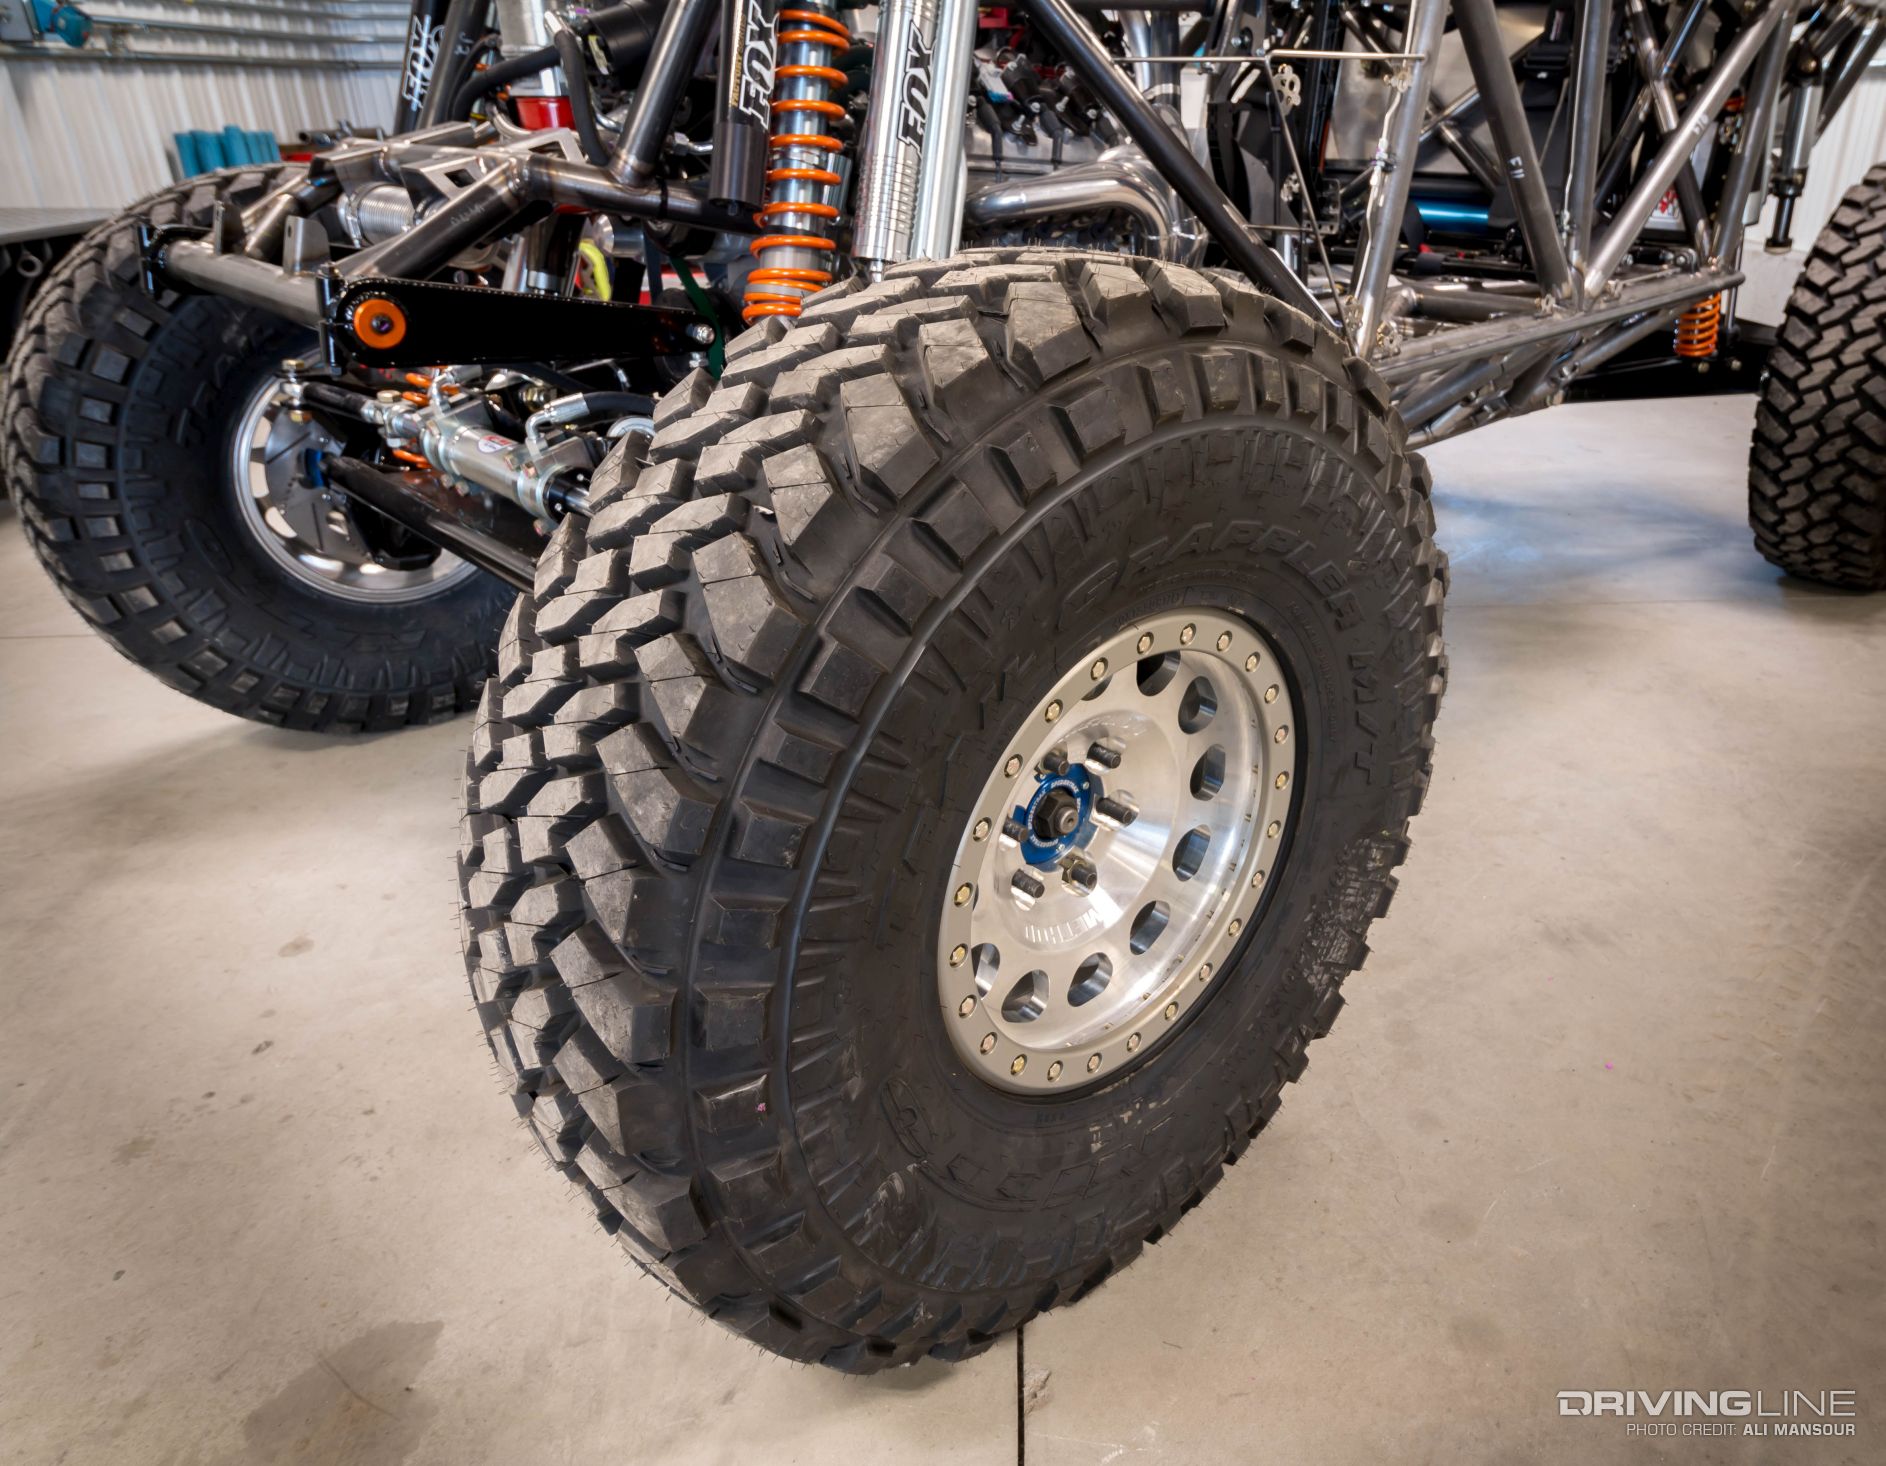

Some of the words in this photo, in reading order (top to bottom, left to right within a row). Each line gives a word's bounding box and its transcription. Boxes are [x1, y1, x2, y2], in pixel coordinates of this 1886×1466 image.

[402, 14, 445, 110] FOX
[739, 0, 780, 130] FOX
[898, 20, 937, 160] FOX
[1056, 519, 1366, 631] GRAPPLER
[1348, 651, 1379, 785] M/T
